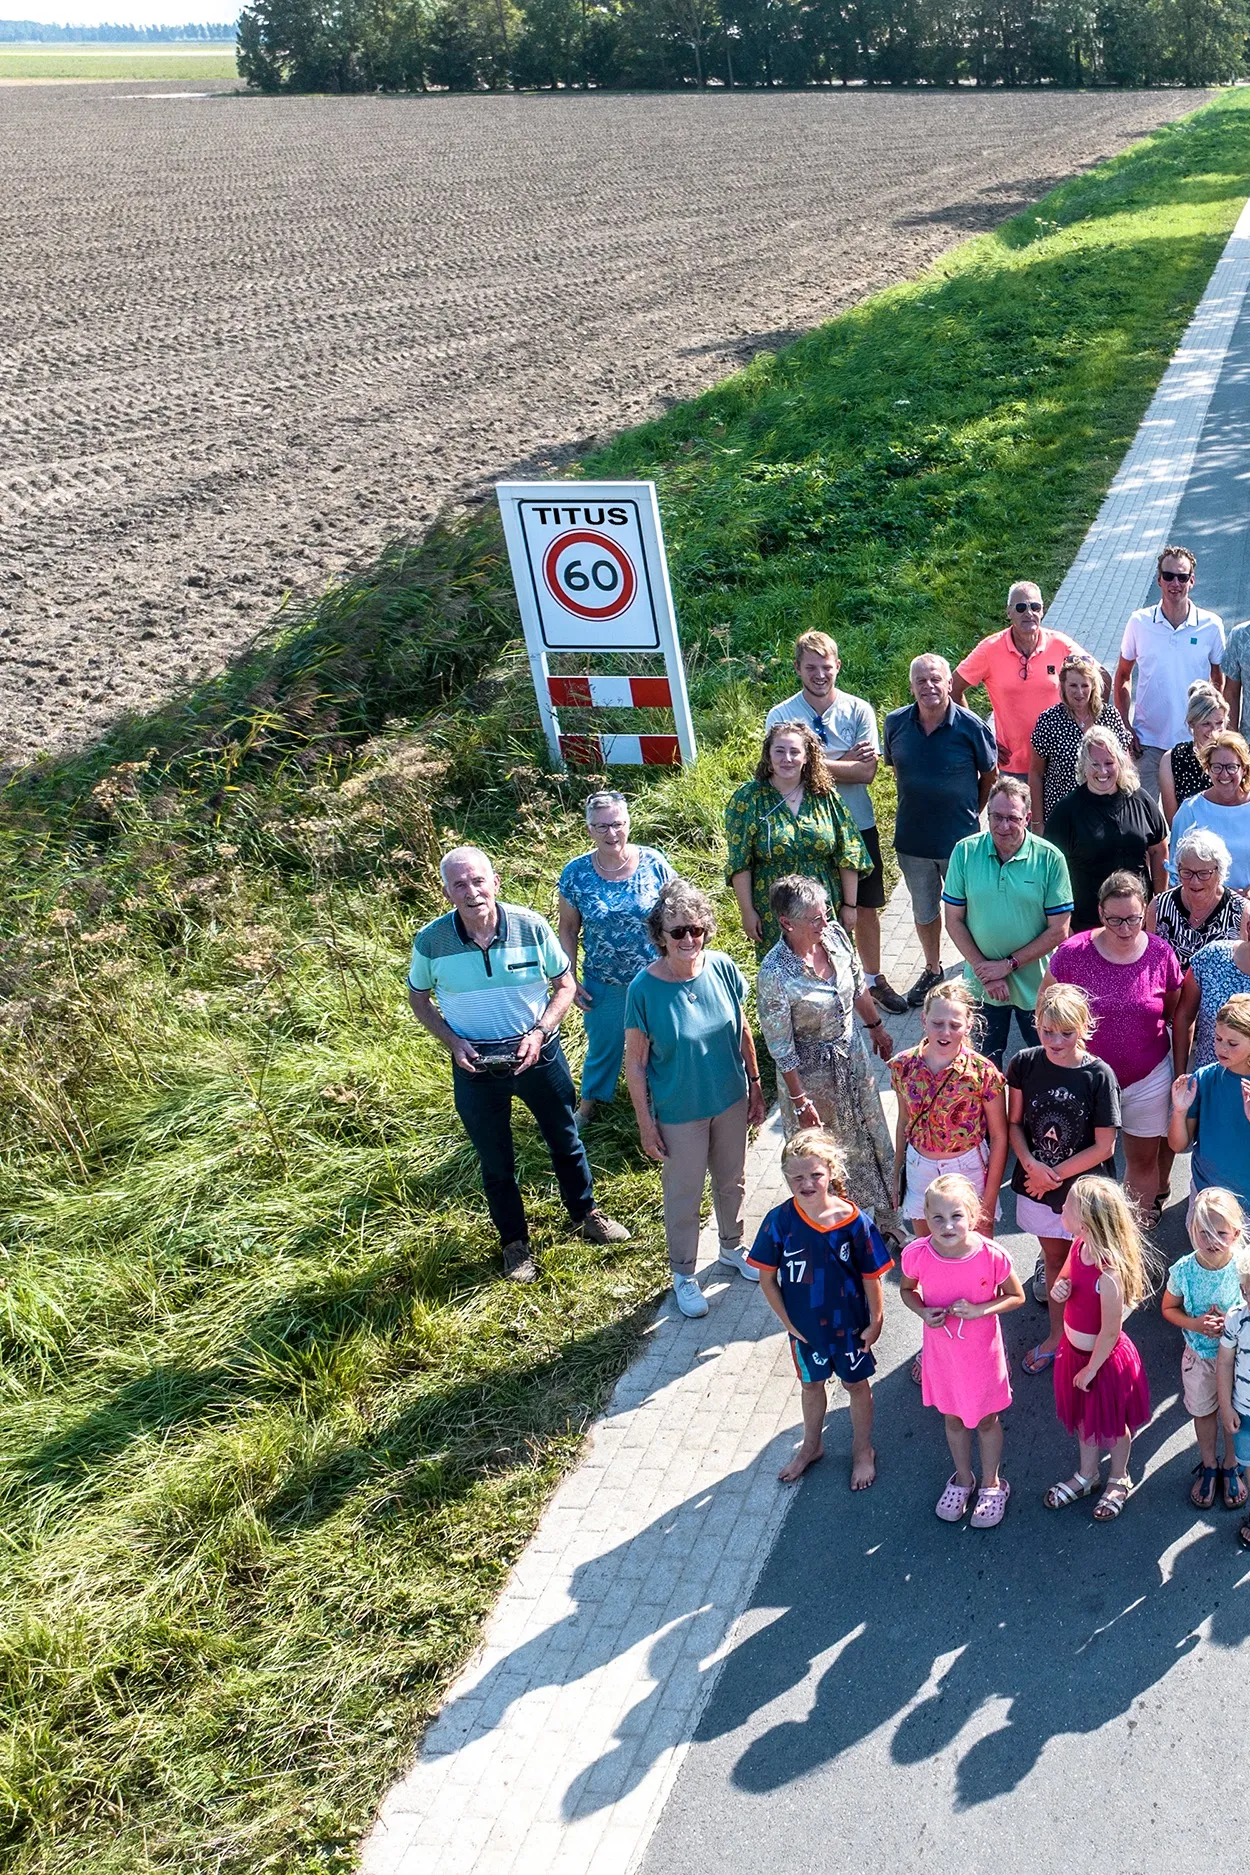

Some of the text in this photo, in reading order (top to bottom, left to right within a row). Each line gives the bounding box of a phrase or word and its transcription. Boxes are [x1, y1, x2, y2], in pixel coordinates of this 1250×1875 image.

[532, 507, 629, 526] TITUS
[564, 559, 618, 591] 60
[786, 1260, 807, 1283] 17
